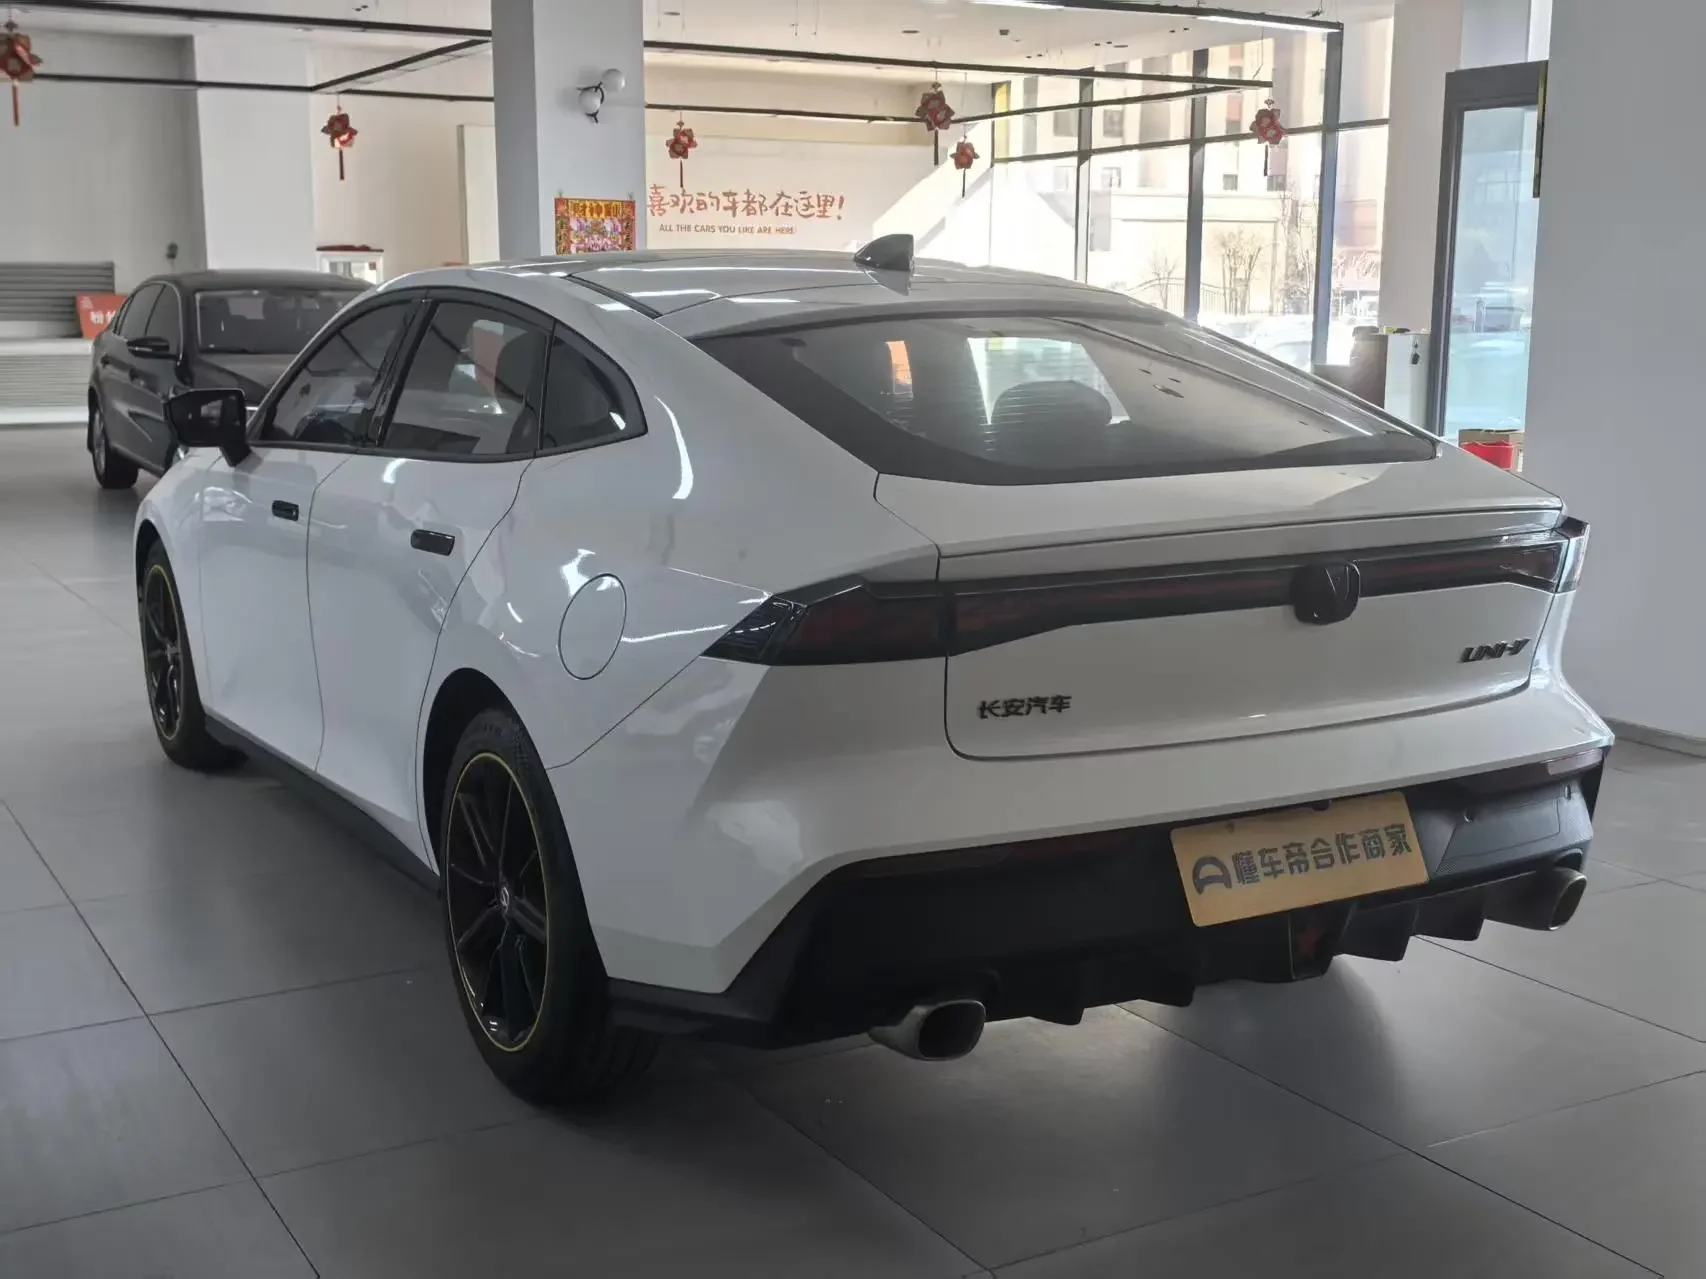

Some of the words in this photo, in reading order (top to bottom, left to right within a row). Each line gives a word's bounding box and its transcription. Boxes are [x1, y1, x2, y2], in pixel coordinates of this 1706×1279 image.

[659, 223, 674, 232] ALL
[676, 224, 692, 233] THE
[694, 224, 716, 233] CARS
[717, 225, 736, 233] YOU
[738, 225, 754, 234] LIKE
[757, 226, 772, 234] ARE
[977, 694, 1072, 719] 长安汽车
[1231, 823, 1412, 885] 懂车帝合作商家
